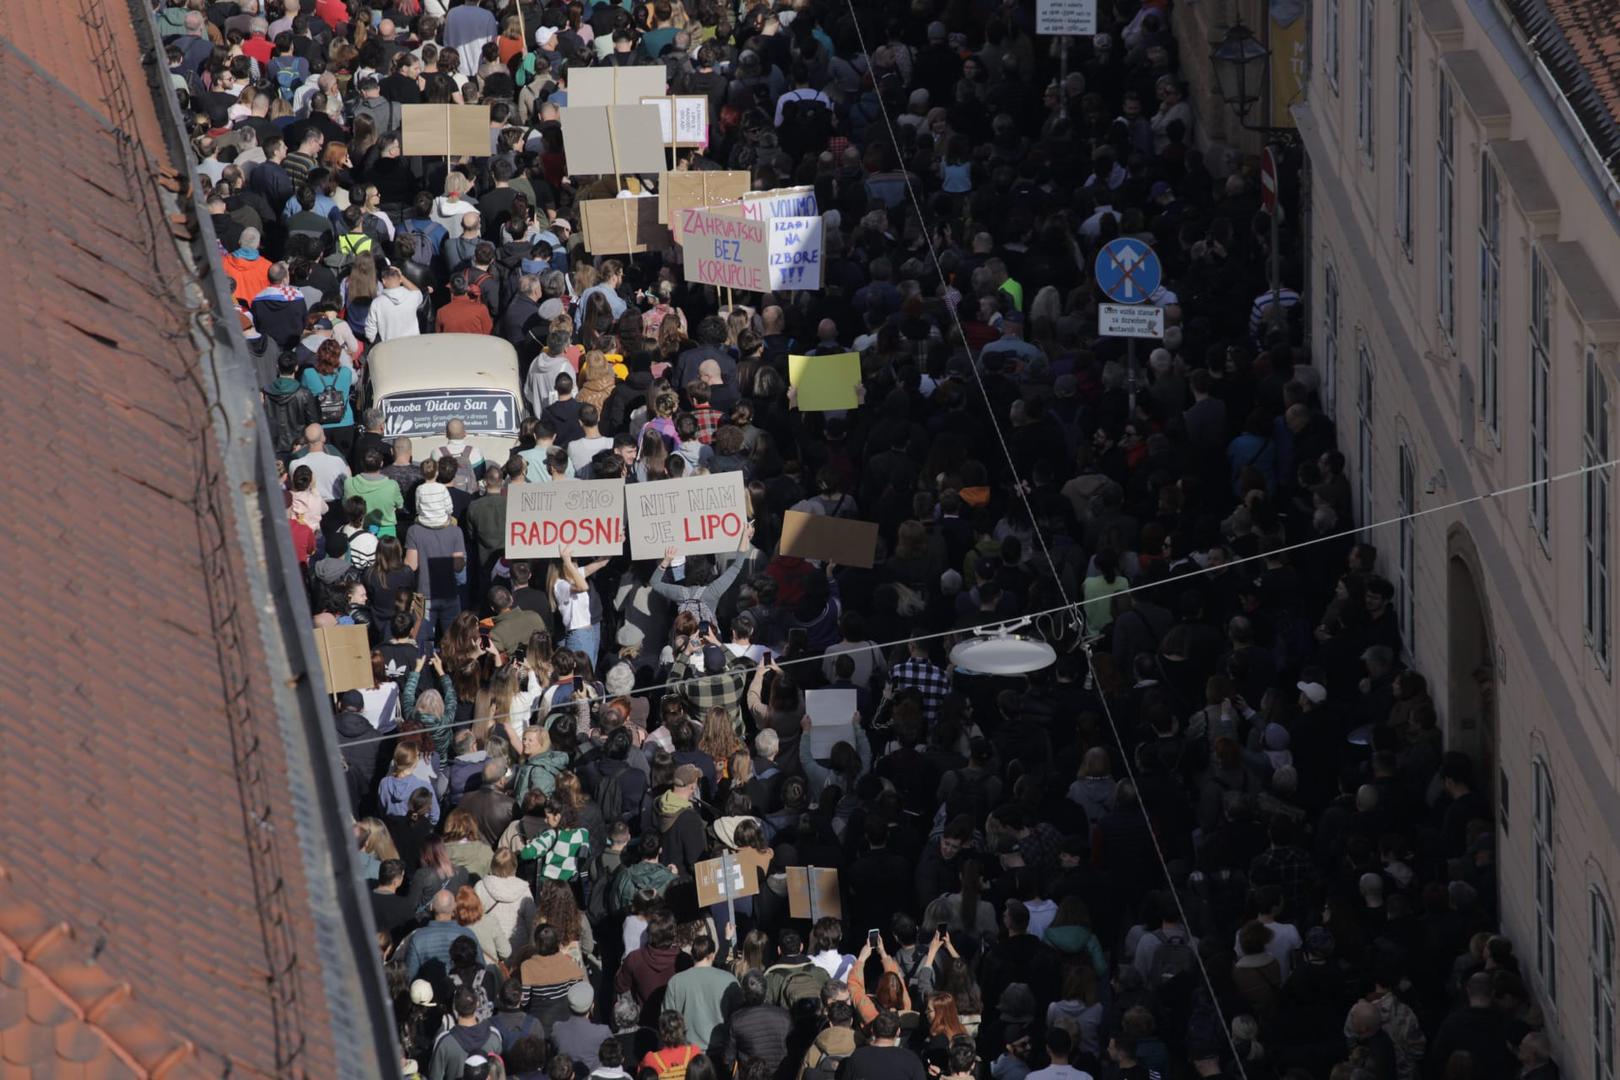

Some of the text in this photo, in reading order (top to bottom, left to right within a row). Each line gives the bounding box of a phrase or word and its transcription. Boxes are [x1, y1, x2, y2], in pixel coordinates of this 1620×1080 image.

[714, 239, 743, 263] BEZ
[784, 233, 801, 246] NA
[770, 249, 819, 266] IZBORE
[697, 259, 762, 290] KORUPCIJE
[425, 399, 461, 412] Didov
[463, 398, 488, 411] San
[521, 488, 614, 512] NIT SMO
[640, 485, 737, 517] NIT NAM
[510, 517, 620, 546] RADOSNI
[644, 512, 741, 544] JE LIPO
